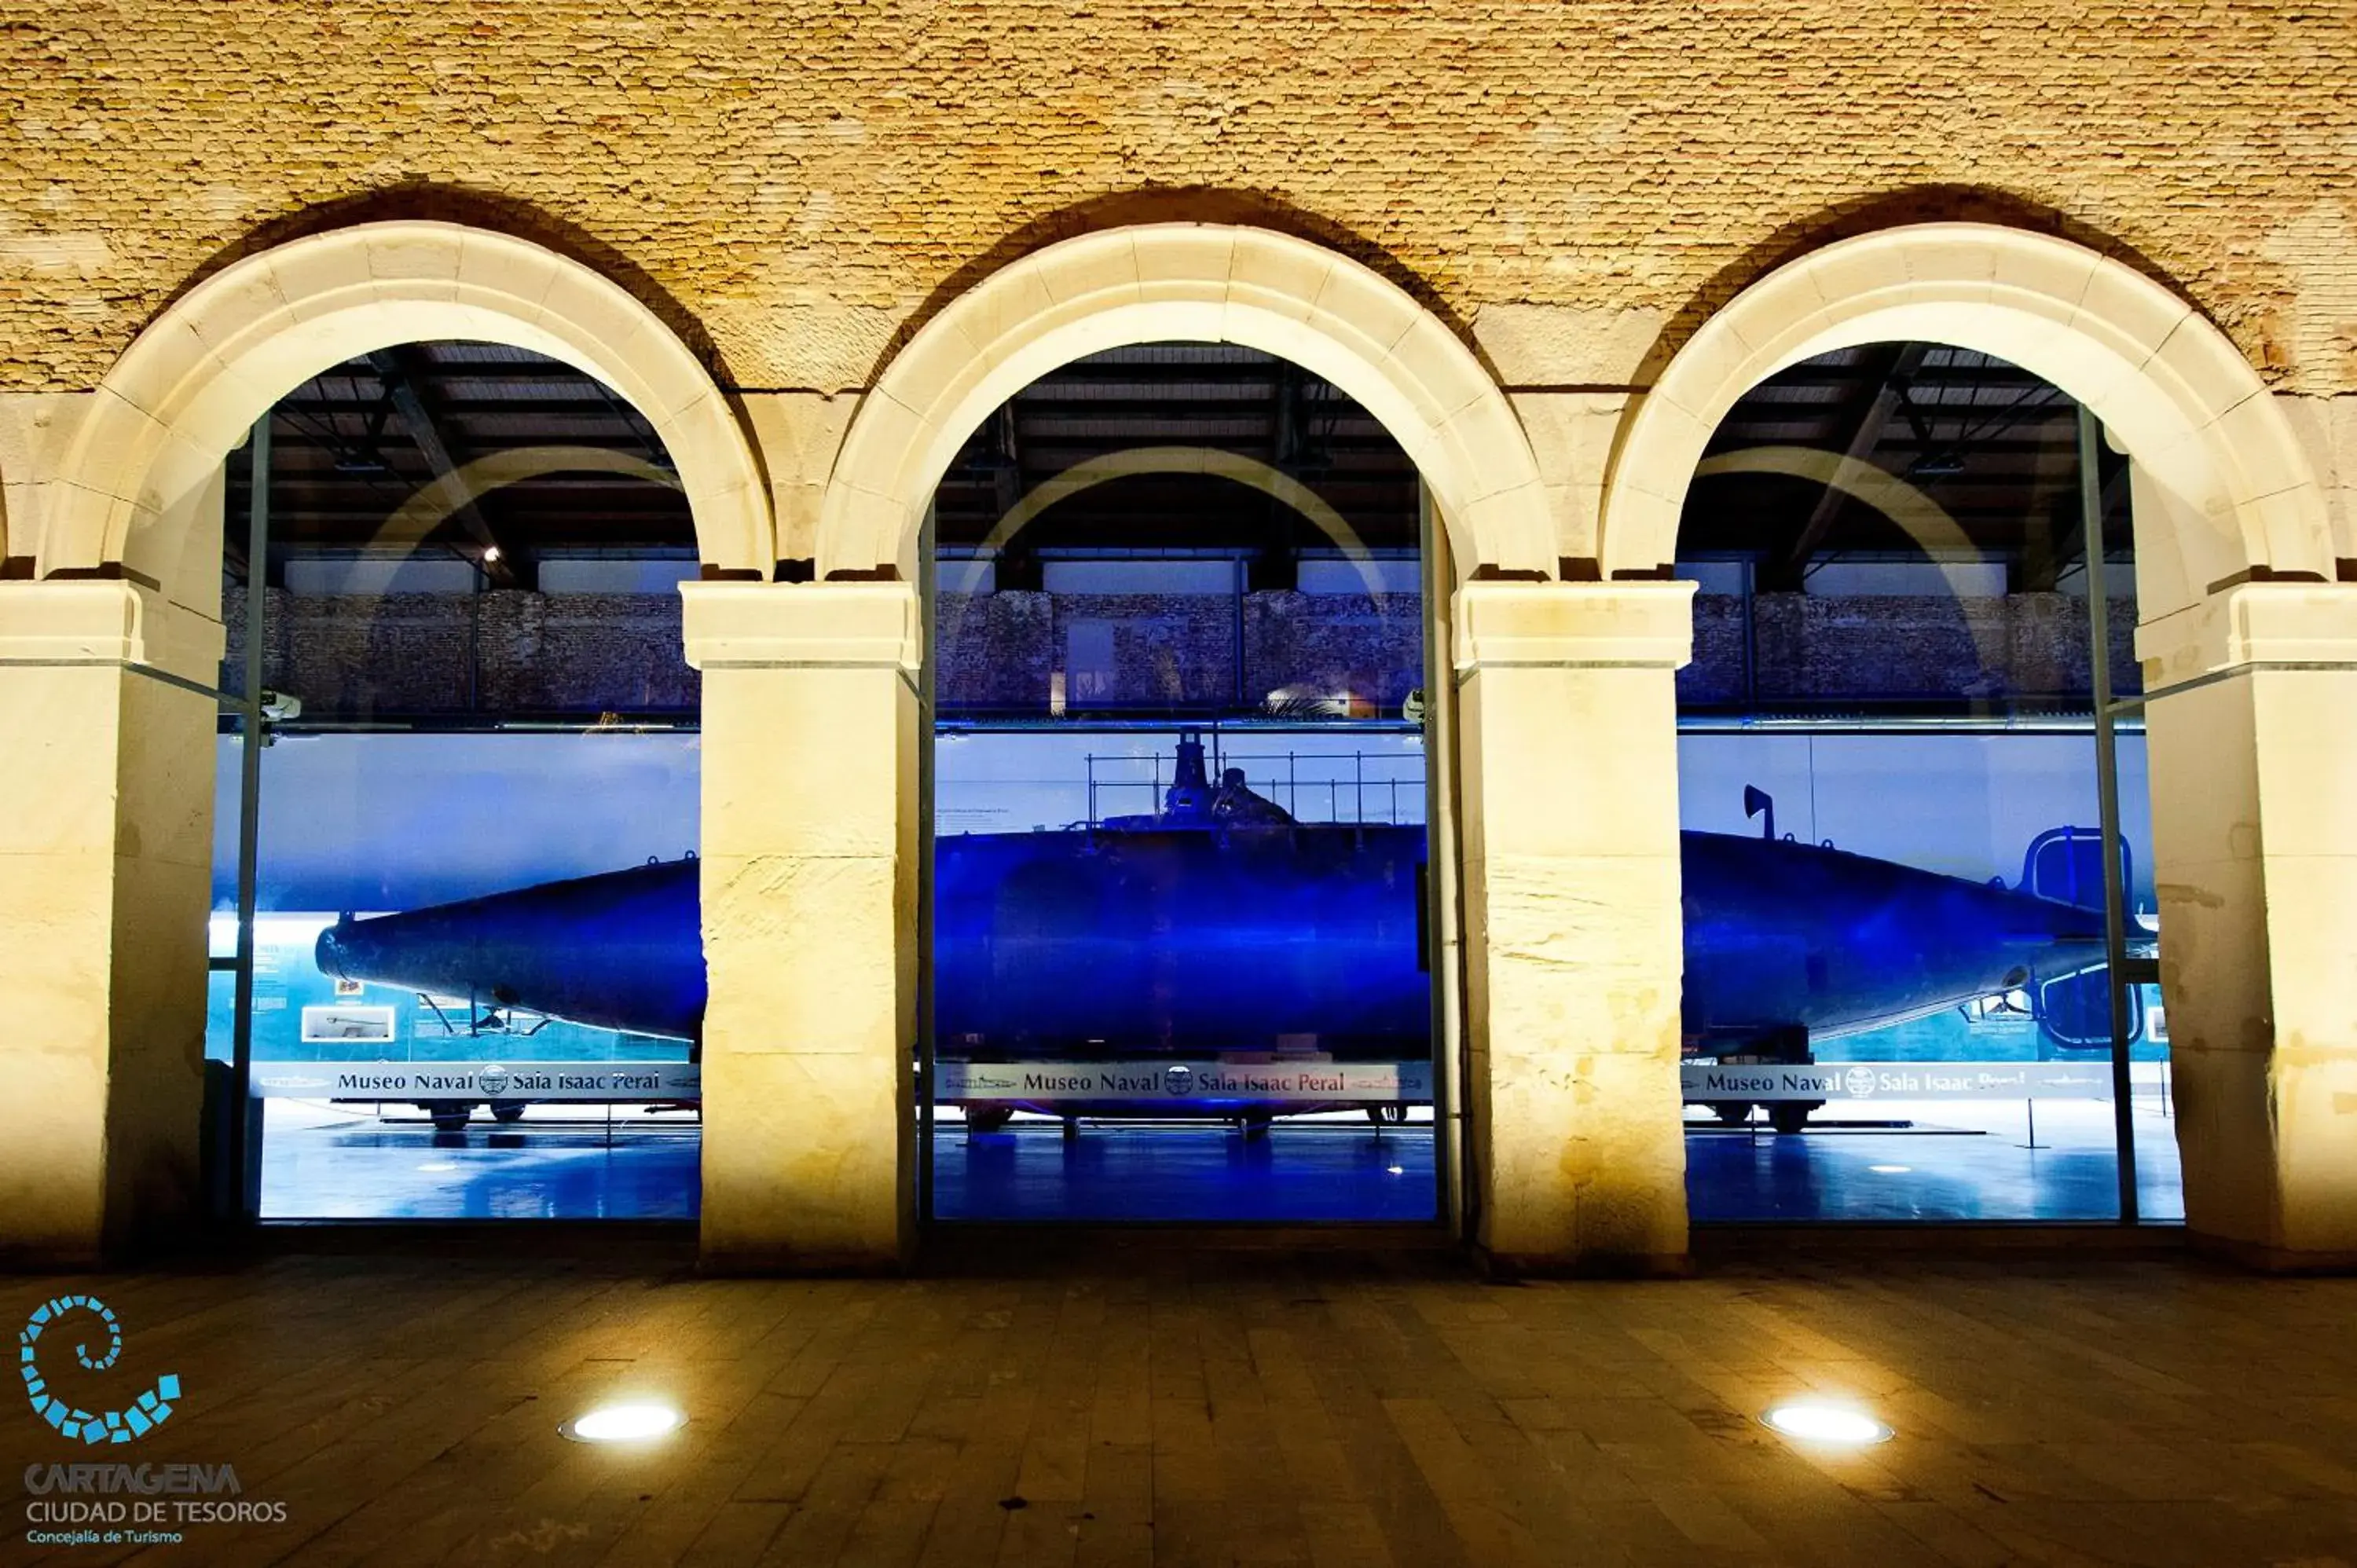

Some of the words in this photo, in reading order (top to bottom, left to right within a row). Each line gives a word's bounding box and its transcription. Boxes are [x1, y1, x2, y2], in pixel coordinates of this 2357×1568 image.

[338, 1073, 406, 1090] Museo
[414, 1072, 473, 1090] Naval
[513, 1072, 551, 1090] Sala
[559, 1073, 607, 1090] Isaac
[612, 1072, 659, 1090] Peral
[1024, 1073, 1092, 1090] Museo
[1101, 1072, 1159, 1090] Naval
[1198, 1072, 1237, 1090] Sala
[1244, 1074, 1291, 1090] Isaac
[1298, 1072, 1344, 1090] Peral
[1706, 1073, 1774, 1090] Museo
[1783, 1072, 1841, 1090] Naval
[1879, 1072, 1919, 1091] Sala
[1925, 1073, 1973, 1091] Isaac
